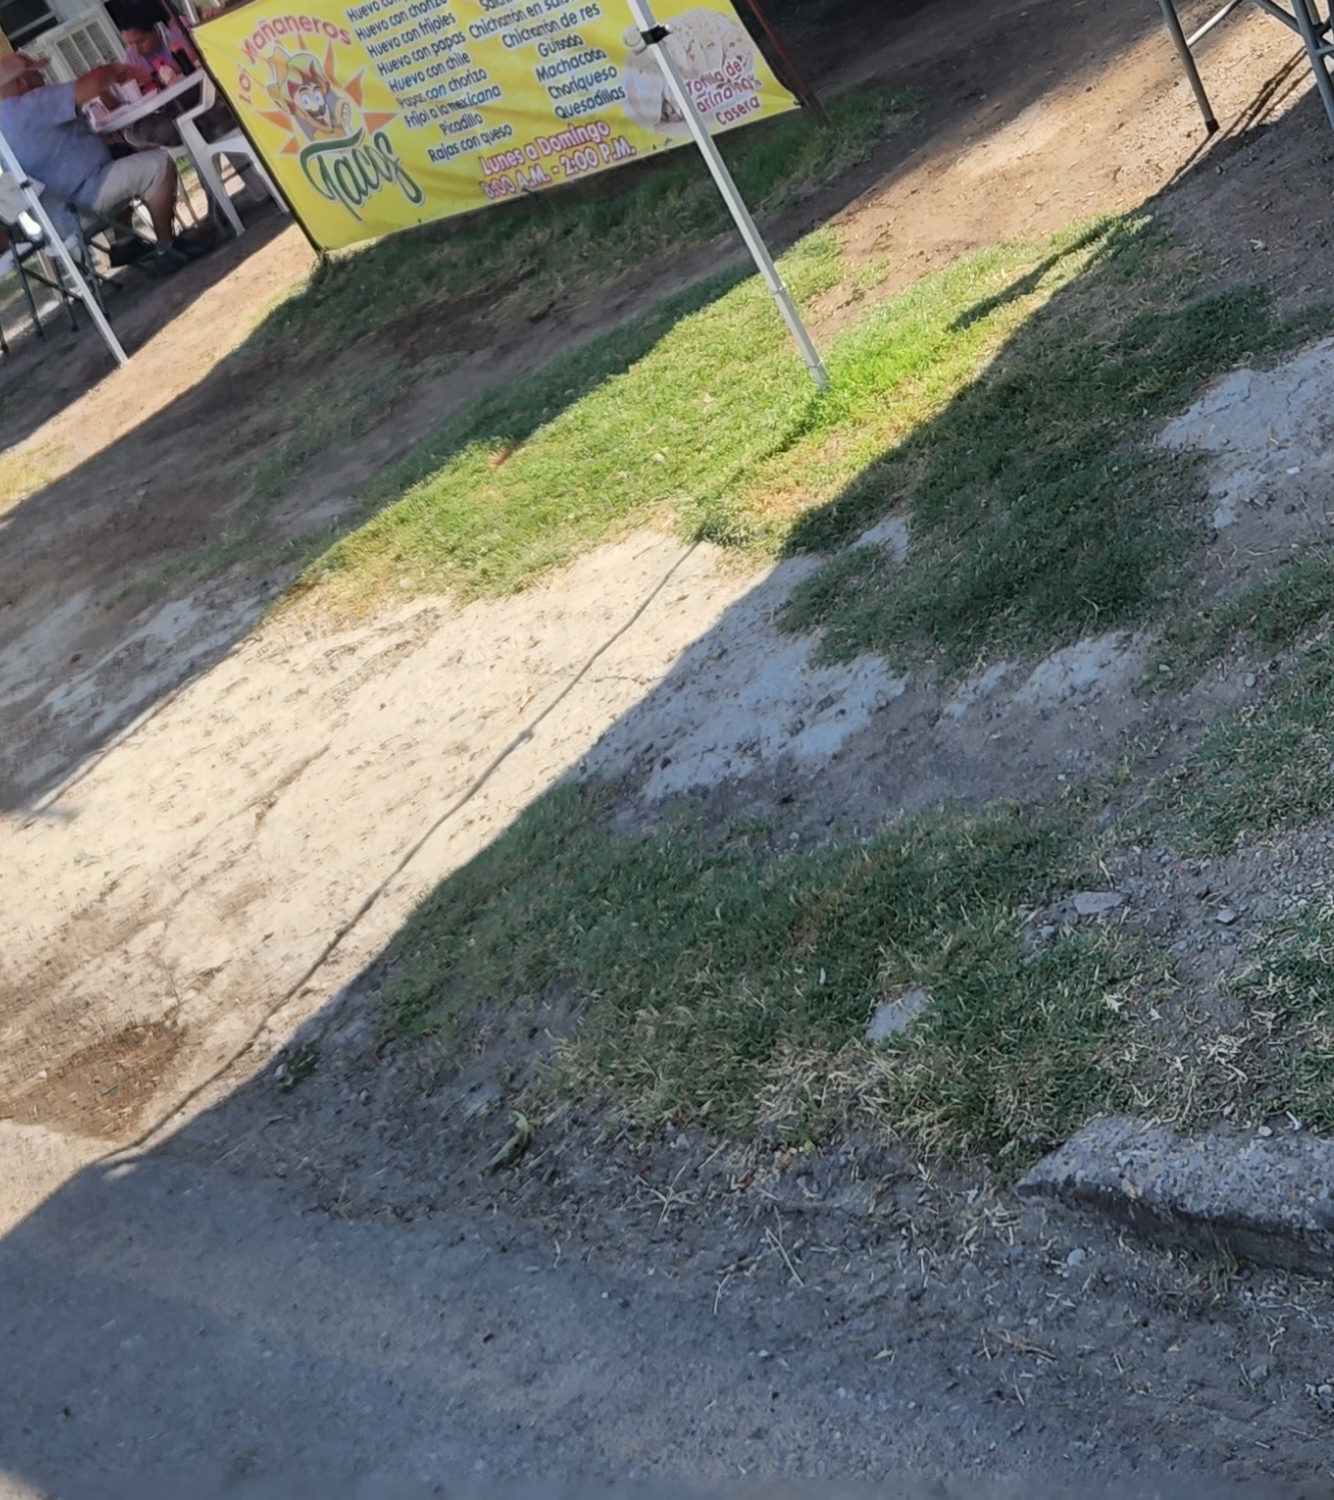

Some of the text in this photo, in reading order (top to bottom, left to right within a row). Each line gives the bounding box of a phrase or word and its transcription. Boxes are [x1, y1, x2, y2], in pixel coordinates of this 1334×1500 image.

[347, 0, 381, 22] Huevo
[355, 18, 389, 41] Huevo
[389, 10, 409, 27] con
[527, 2, 543, 18] en
[560, 12, 577, 28] de
[580, 3, 601, 20] res
[241, 15, 352, 66] Mañaneros
[367, 12, 456, 58] Huevo con frijoles
[537, 34, 584, 58] Guisado
[377, 30, 467, 76] Huevo con papas
[388, 51, 471, 92] Huevo con chile
[396, 68, 487, 109] Papas con chorizo
[548, 66, 617, 100] Choriqueso
[686, 60, 743, 95] Tortilla de
[403, 84, 502, 128] Frijol a la mexicana
[555, 85, 626, 120] Quesadillas
[696, 85, 733, 113] arina
[716, 95, 761, 126] Casera
[439, 112, 483, 136] Picadillo
[427, 124, 513, 163] Rajas con queso
[479, 119, 610, 176] Lunes a Domingo
[299, 127, 423, 222] Tacos
[480, 175, 516, 199] 8:00
[515, 164, 551, 188] A.M.
[561, 147, 599, 176] 2:00
[598, 136, 637, 164] P.M.
